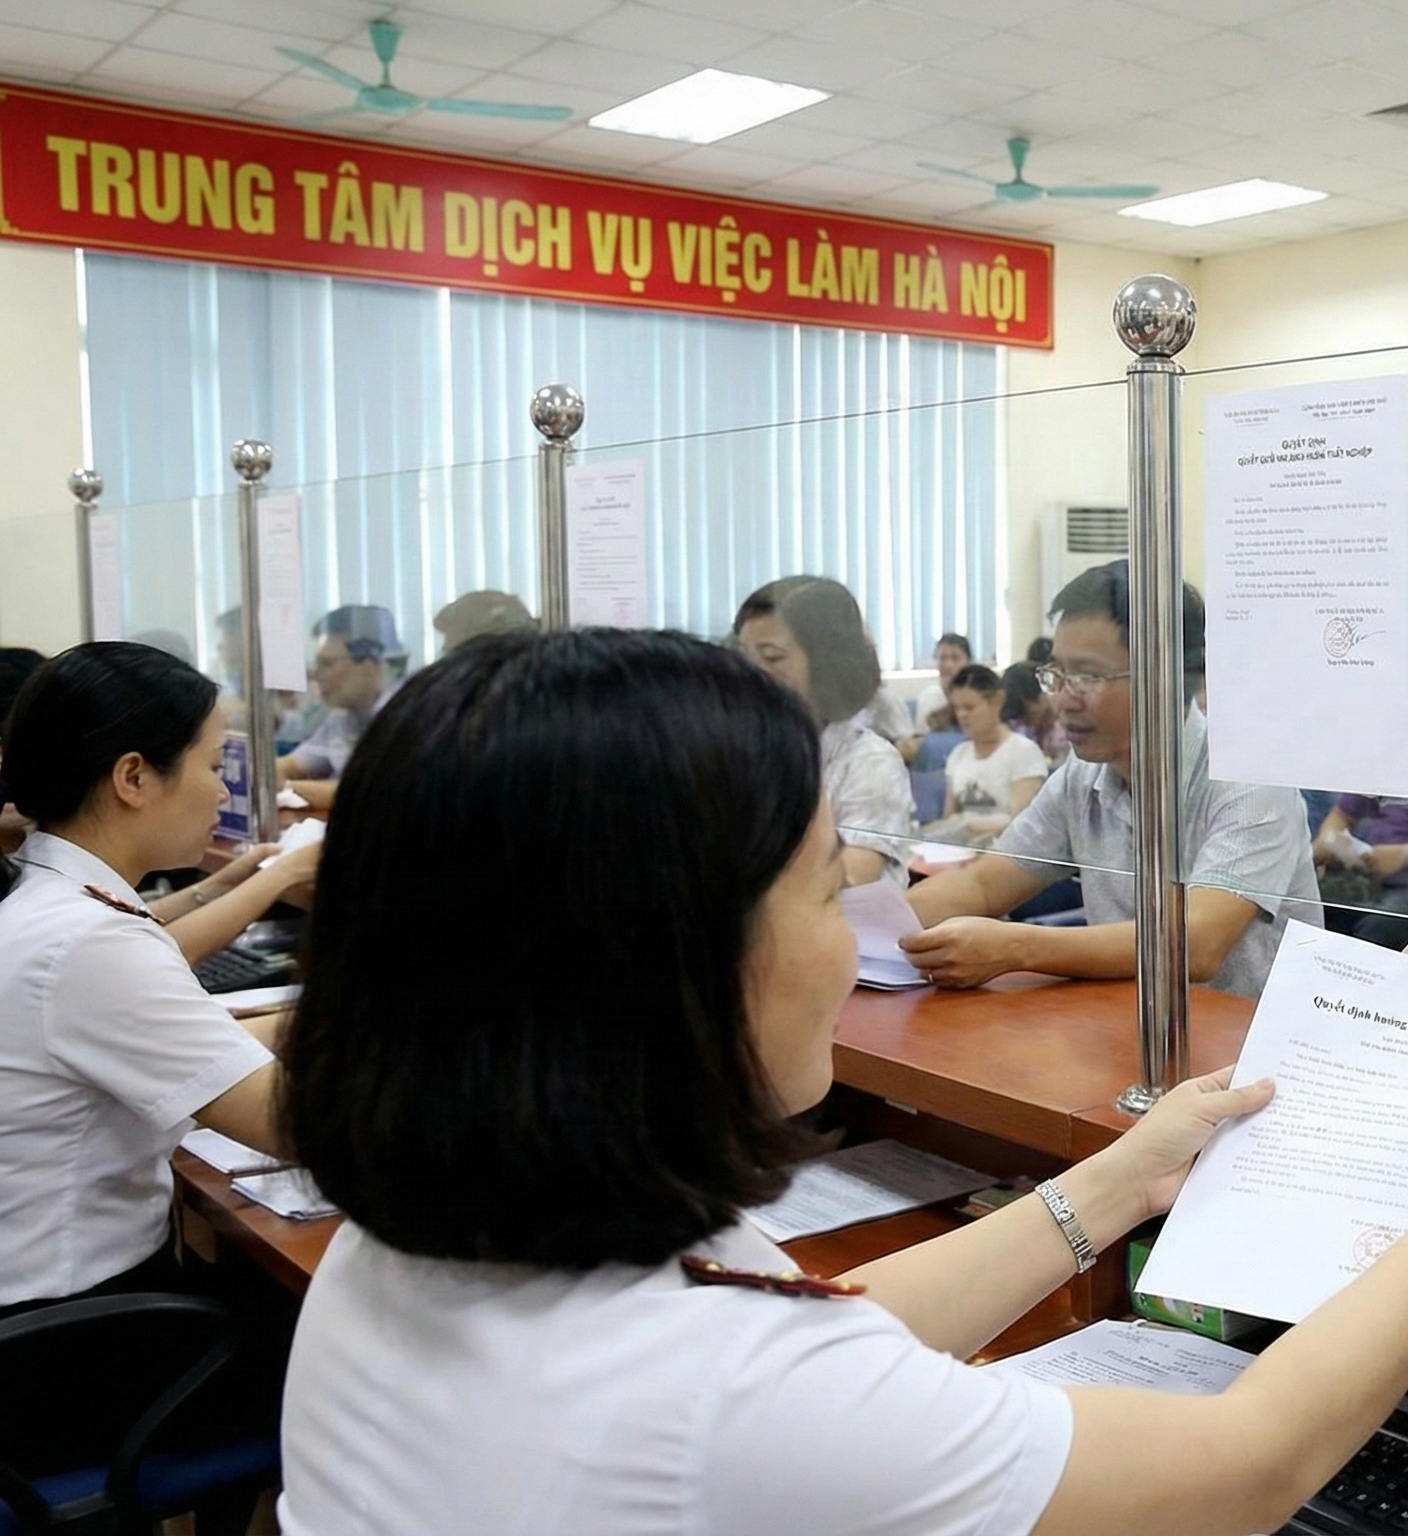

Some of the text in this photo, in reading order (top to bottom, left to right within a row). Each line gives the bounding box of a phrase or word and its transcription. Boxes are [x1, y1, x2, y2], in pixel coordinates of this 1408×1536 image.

[47, 136, 1027, 333] TRUNG TÂM DỊCH VỤ VIỆC LÀM HÀ NỘI
[1313, 995, 1345, 1013] Quyết
